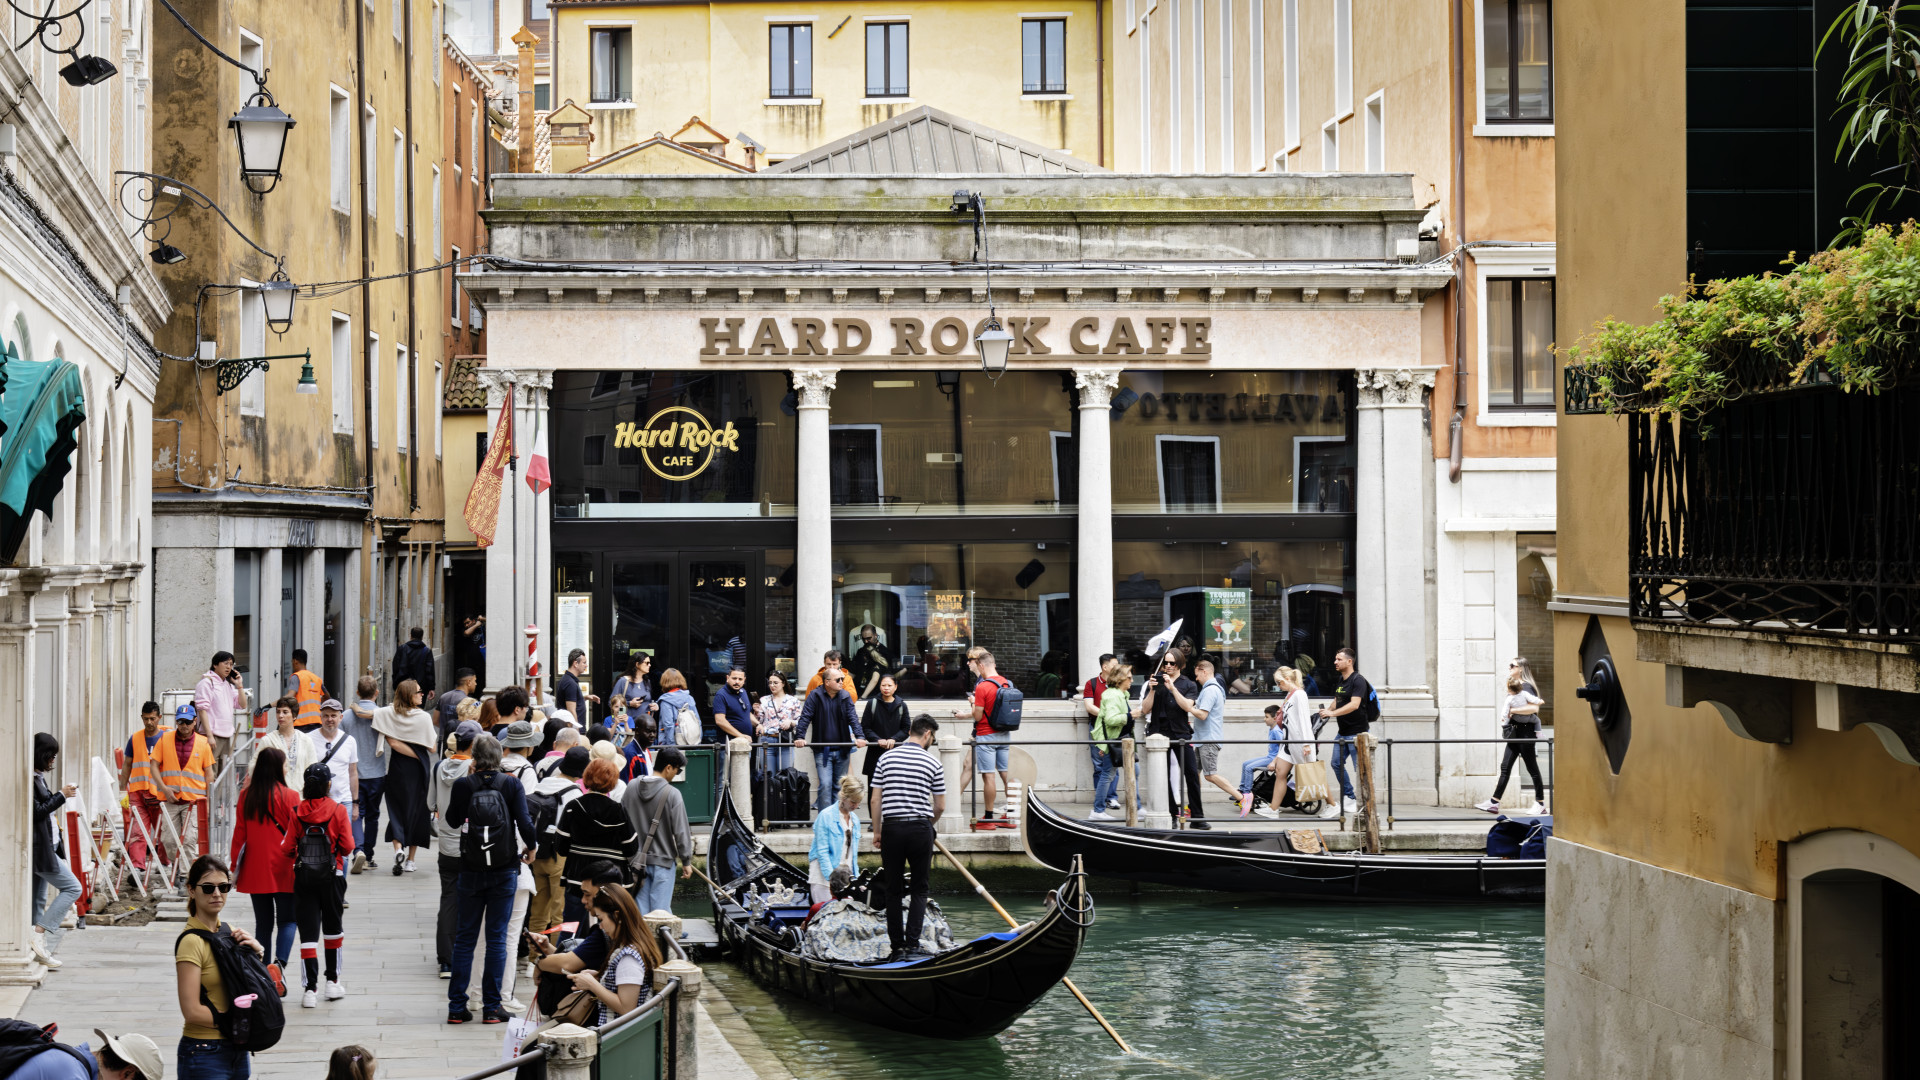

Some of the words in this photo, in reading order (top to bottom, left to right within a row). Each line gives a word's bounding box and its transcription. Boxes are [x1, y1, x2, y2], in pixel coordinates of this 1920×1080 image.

[700, 317, 872, 355] HARD
[1070, 316, 1211, 354] CAFE
[614, 421, 678, 448] Hard
[680, 421, 740, 452] Rock
[662, 456, 694, 466] CAFE
[935, 594, 964, 602] PARTY
